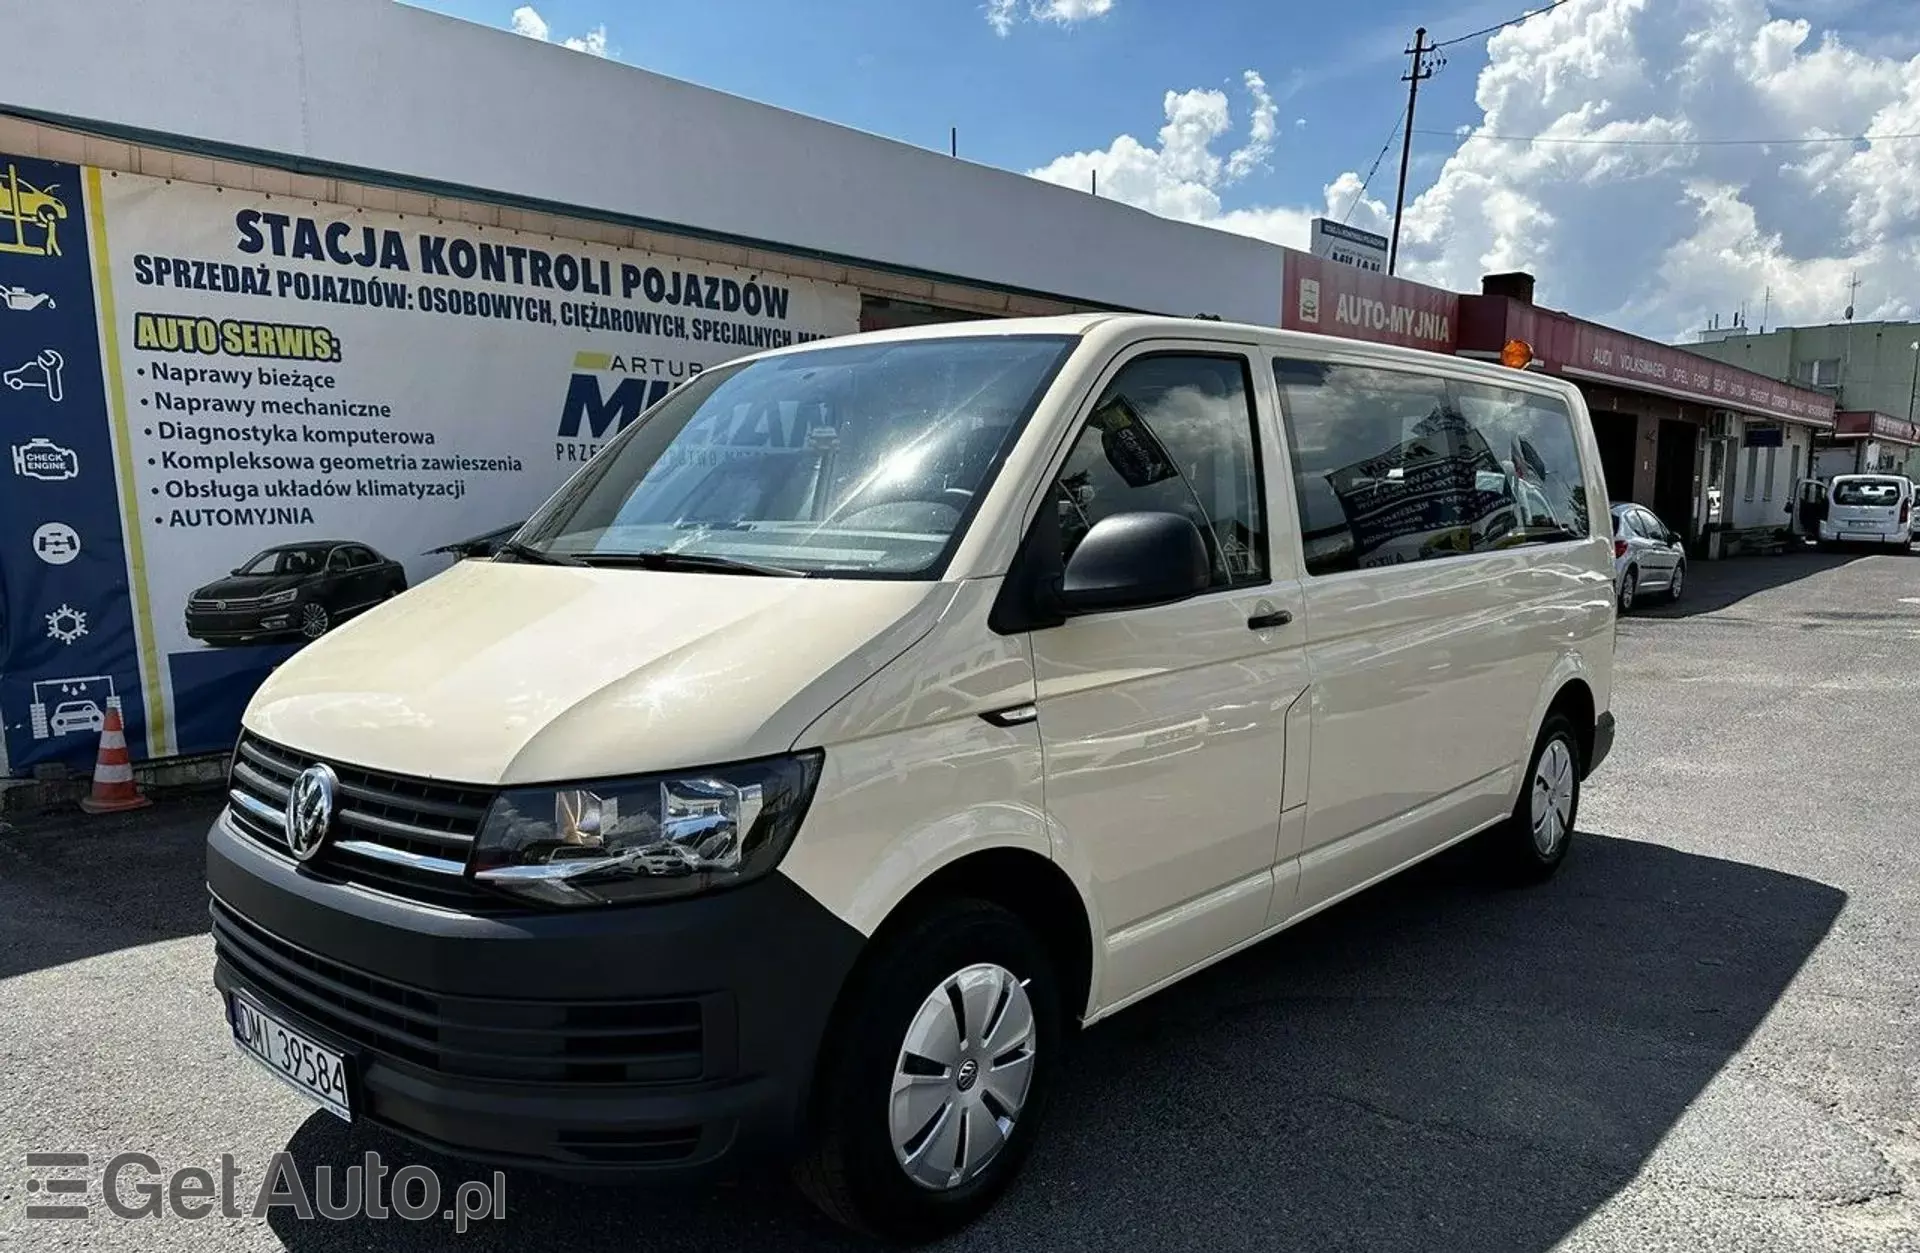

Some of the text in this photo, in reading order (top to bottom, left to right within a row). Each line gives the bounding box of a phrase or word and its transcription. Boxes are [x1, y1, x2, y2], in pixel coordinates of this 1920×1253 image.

[236, 209, 788, 319] STACJA KONTROLI POJAZDÓW
[134, 254, 272, 296] SPRZEDAŻ
[276, 270, 414, 310] POJAZDÓW:
[418, 286, 558, 326] OSOBOWYCH,
[560, 301, 690, 340] CIĘŻAROWYCH,
[1335, 293, 1450, 343] AUTO-MYJNIA
[134, 312, 342, 362] AUTO SERWIS:
[151, 361, 335, 392] Naprawy bieżące
[611, 355, 704, 377] ARTUR
[155, 391, 391, 417] Naprawy mechaniczne
[158, 421, 435, 447] Diagnostyka komputerowa
[26, 453, 63, 462] CHECK
[27, 461, 67, 470] ENGINE
[162, 451, 522, 474] Kompleksowa geometria zawieszenia
[165, 479, 466, 502] Obsługa układów klimatyzacji
[169, 507, 315, 527] AUTOMYJNIA
[239, 1002, 347, 1105] DMI 39584
